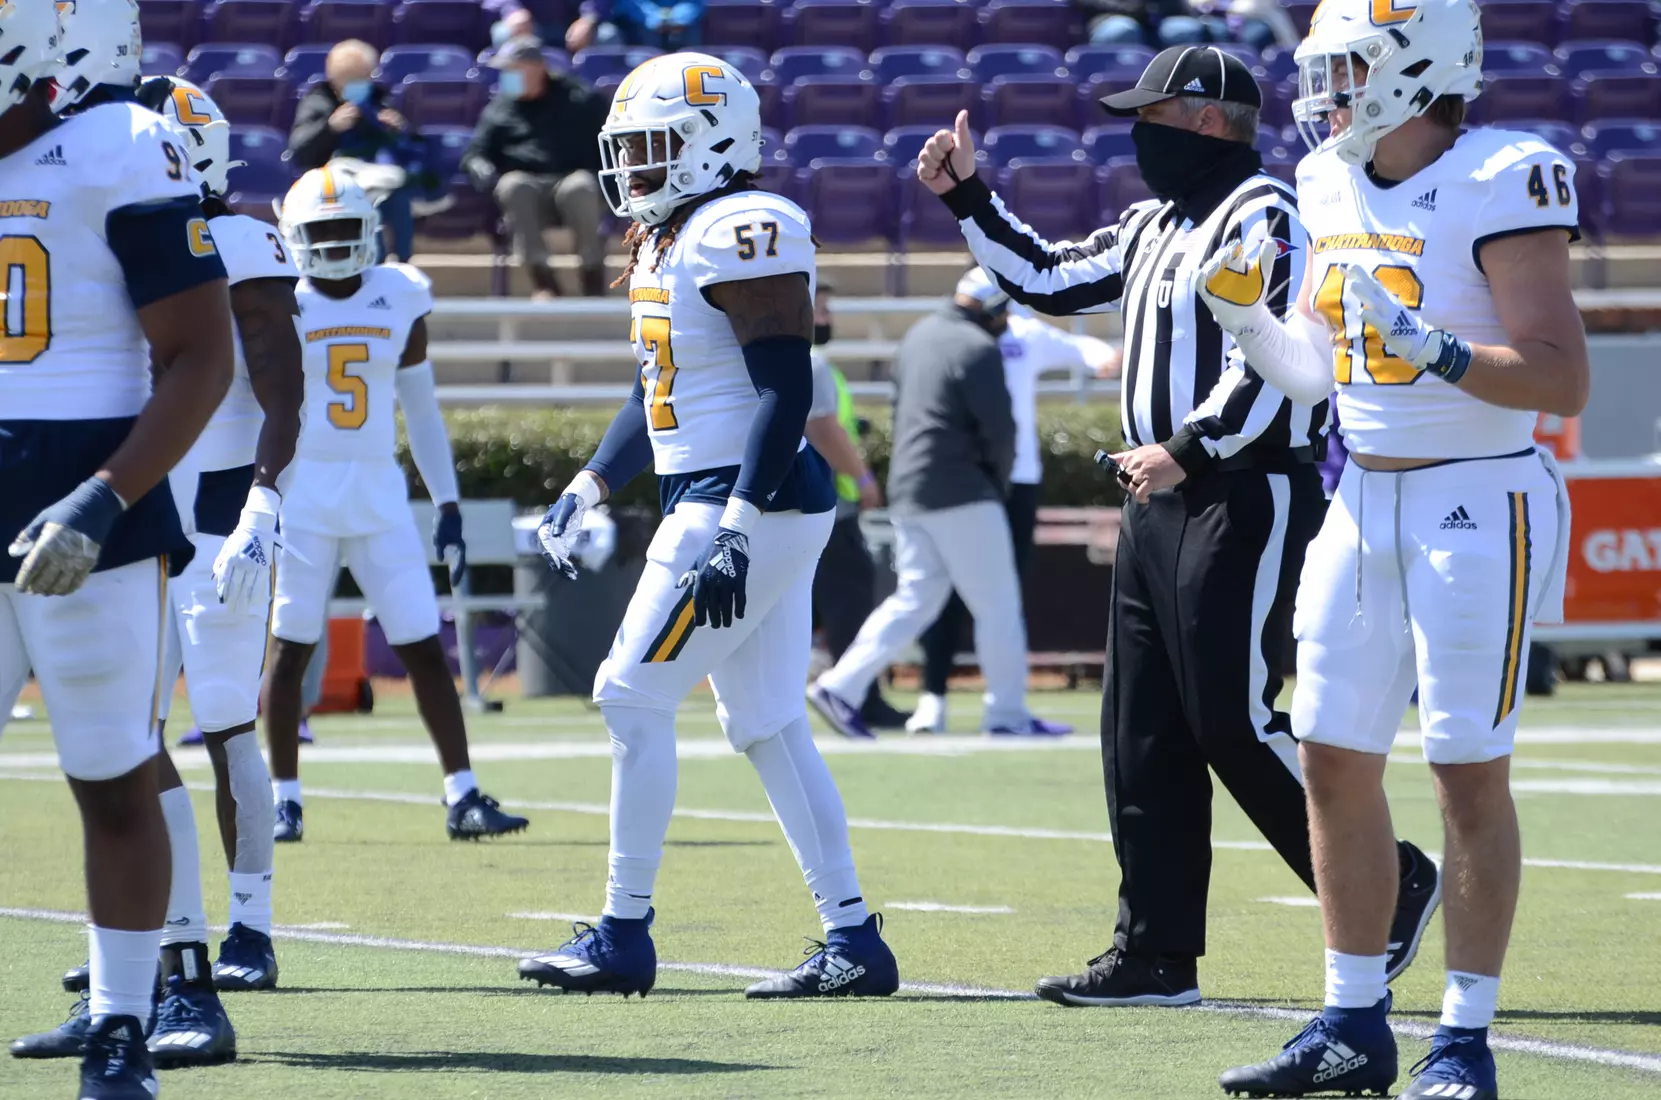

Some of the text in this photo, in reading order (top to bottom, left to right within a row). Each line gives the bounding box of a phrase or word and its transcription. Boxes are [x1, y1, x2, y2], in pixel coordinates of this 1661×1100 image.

[116, 44, 128, 57] 30
[682, 65, 727, 107] C
[172, 86, 212, 126] C
[1527, 163, 1572, 208] 46
[1411, 199, 1437, 211] adidas
[266, 232, 288, 264] 3
[733, 221, 779, 262] 57
[1314, 232, 1426, 257] CHATTANOOGA
[1390, 326, 1418, 336] adidas
[326, 343, 369, 429] 5
[629, 314, 680, 432] 7
[1439, 518, 1478, 530] adidas
[723, 543, 737, 578] adidas
[818, 964, 866, 992] adidas
[1312, 1053, 1369, 1084] adidas
